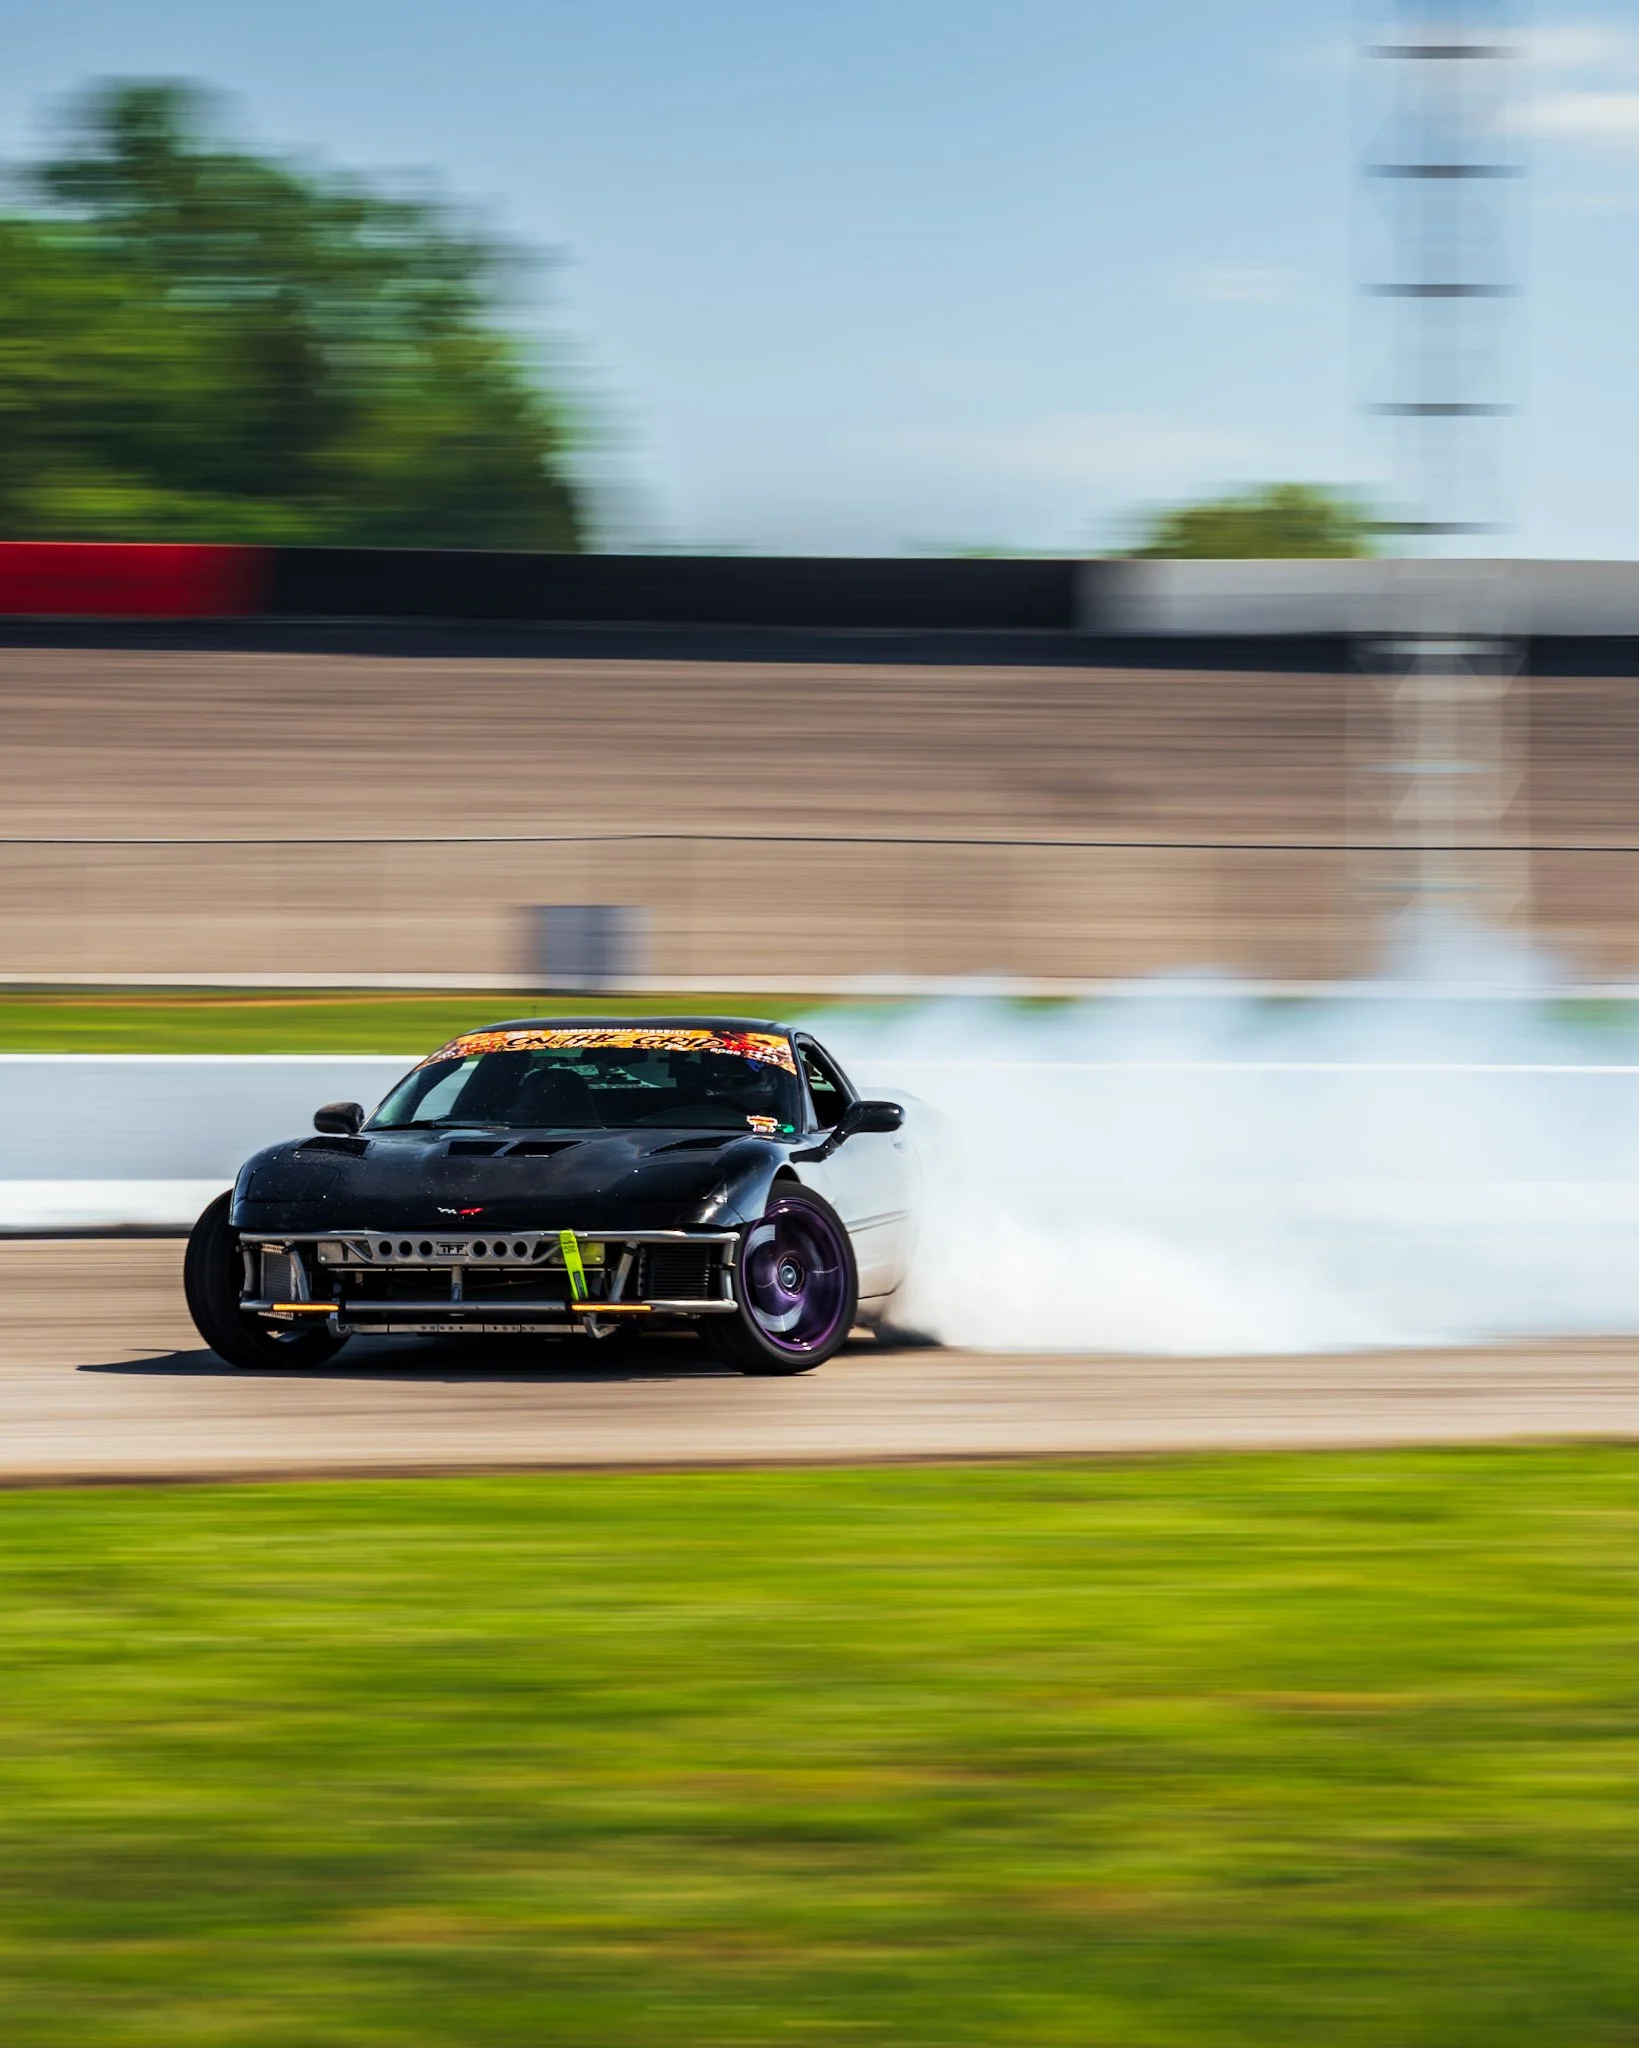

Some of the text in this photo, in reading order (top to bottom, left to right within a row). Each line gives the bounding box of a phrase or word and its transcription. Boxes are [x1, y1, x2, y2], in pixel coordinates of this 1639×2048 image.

[507, 1033, 724, 1048] ON THE GRID
